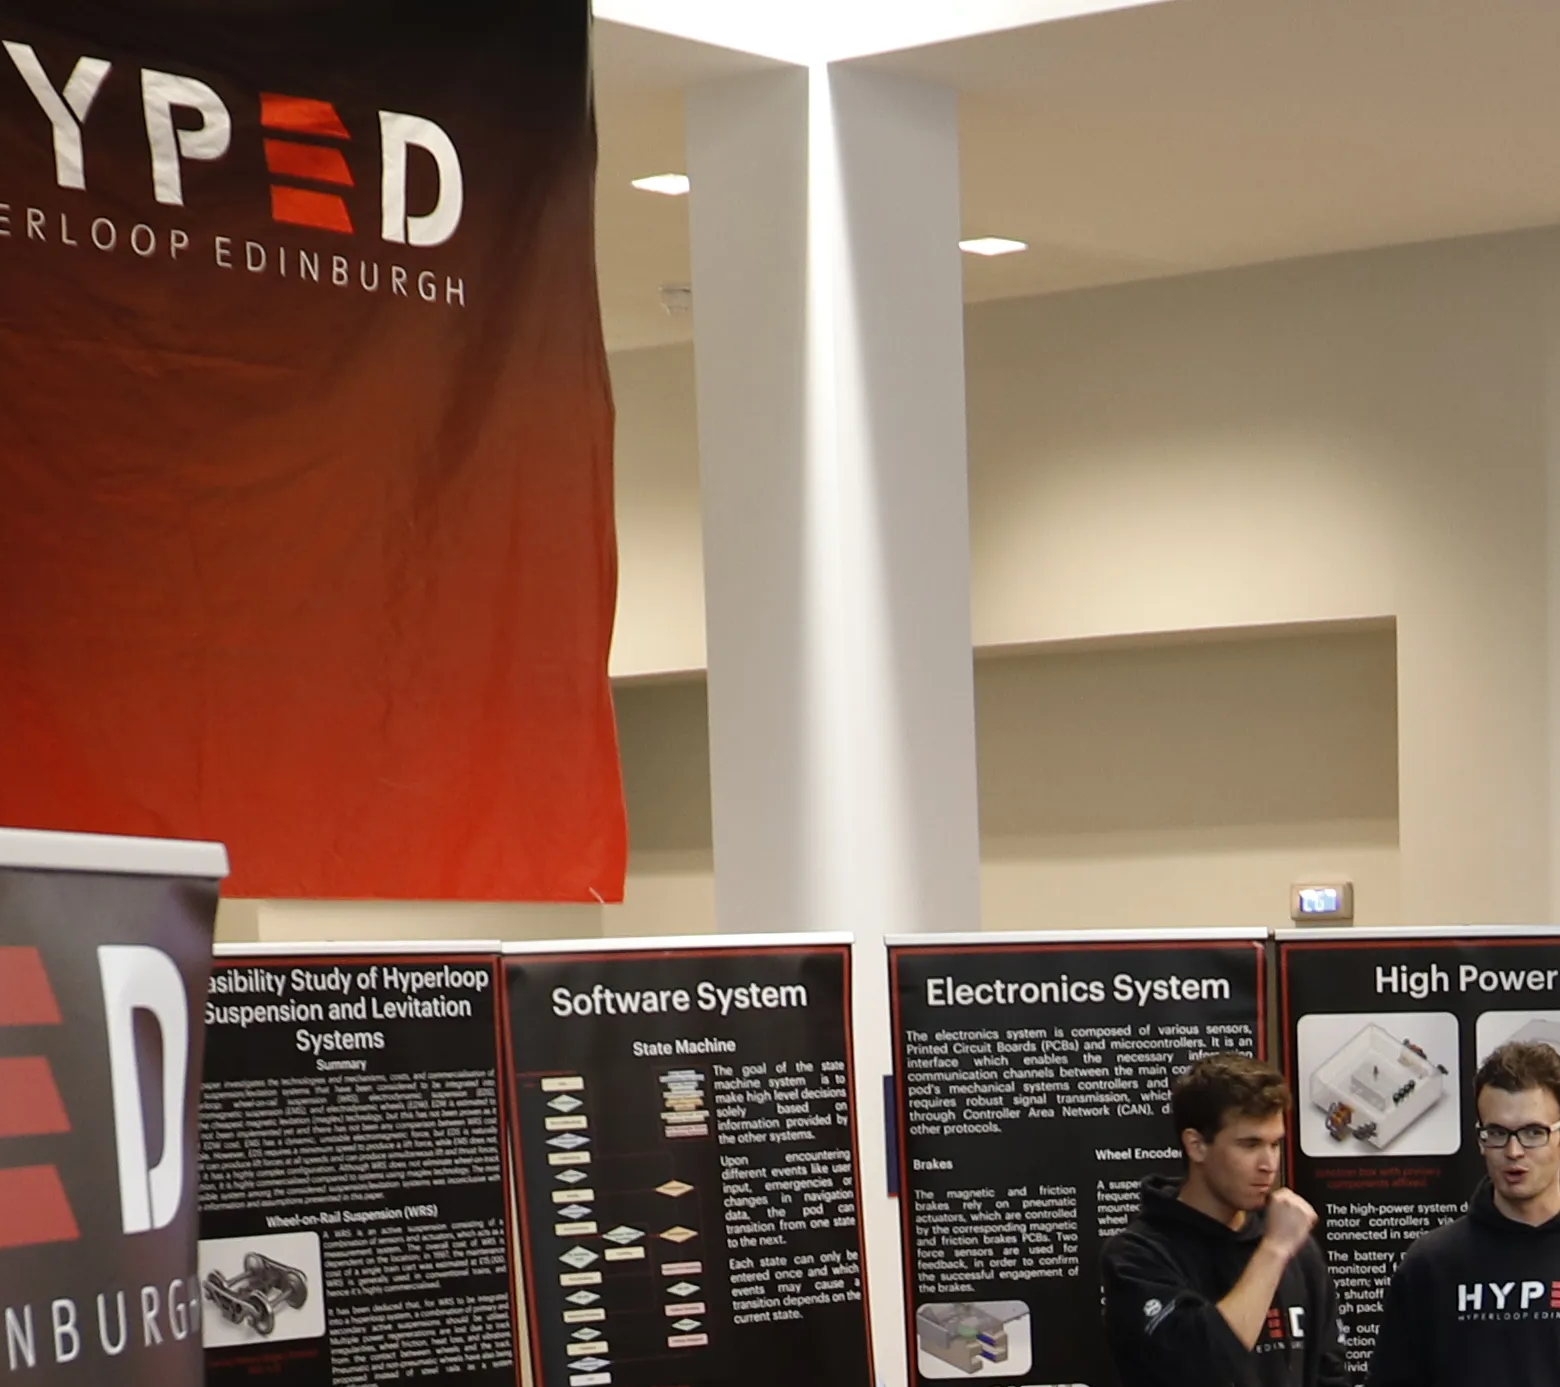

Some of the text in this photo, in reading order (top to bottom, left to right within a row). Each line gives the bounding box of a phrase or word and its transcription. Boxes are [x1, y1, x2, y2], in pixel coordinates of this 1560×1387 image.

[214, 235, 468, 308] EDINBURGH
[208, 965, 489, 996] asibility Study of Hyperloop
[926, 972, 1231, 1009] Electronics System
[1374, 963, 1559, 998] High Power
[204, 995, 472, 1027] Suspension and Levitation
[551, 980, 808, 1017] Software System
[296, 1028, 385, 1055] Systems
[906, 1030, 928, 1043] The
[935, 1029, 999, 1042] electronics
[1006, 1028, 1047, 1041] system
[1054, 1027, 1064, 1038] is
[1071, 1025, 1132, 1040] composed
[1139, 1024, 1151, 1037] of
[1158, 1024, 1199, 1036] various
[633, 1036, 736, 1058] State Machine
[316, 1058, 367, 1072] Summary
[713, 1060, 845, 1077] The goal of the state
[913, 1158, 954, 1171] Brakes
[1095, 1148, 1132, 1161] Wheel
[266, 1203, 438, 1229] Wheel-on-Rail Suspension (WRS)
[1326, 1202, 1456, 1216] The high-power system
